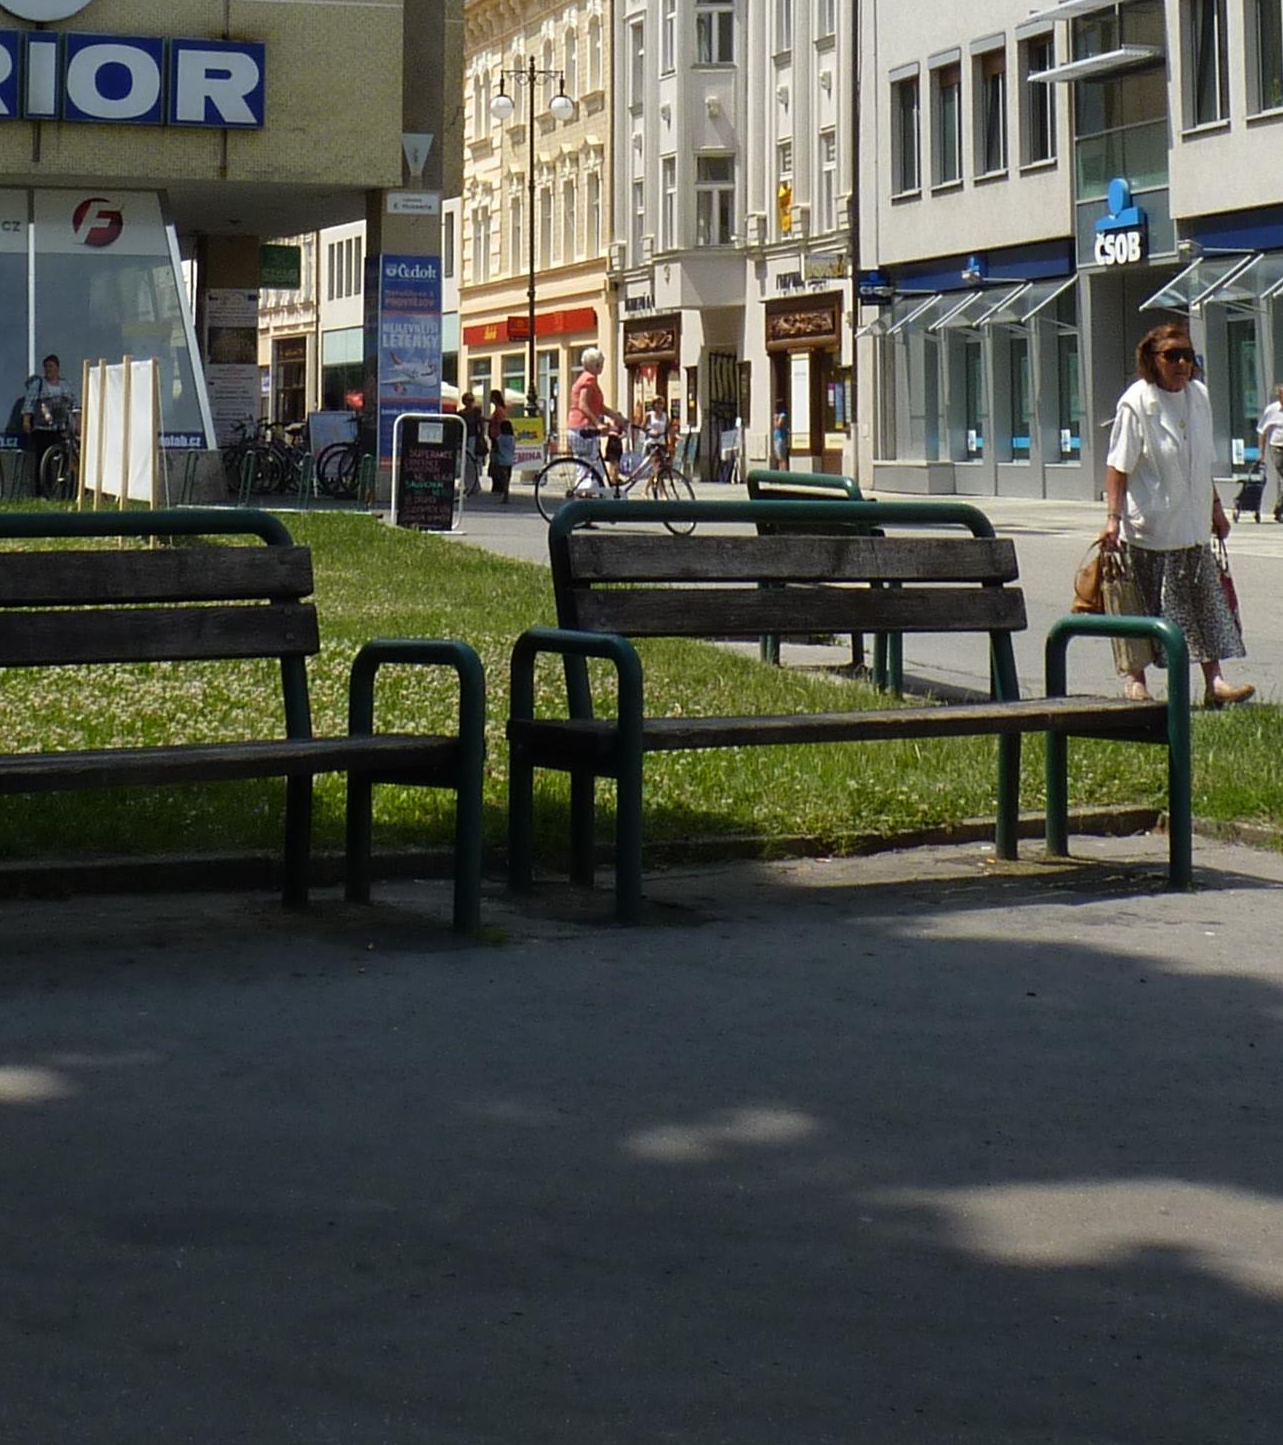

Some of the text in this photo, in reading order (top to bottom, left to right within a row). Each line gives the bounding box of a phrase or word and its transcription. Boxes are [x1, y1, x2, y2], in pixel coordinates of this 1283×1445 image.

[1094, 232, 1141, 266] ČSOB
[398, 262, 437, 279] Čedok
[383, 334, 438, 348] LETENKY
